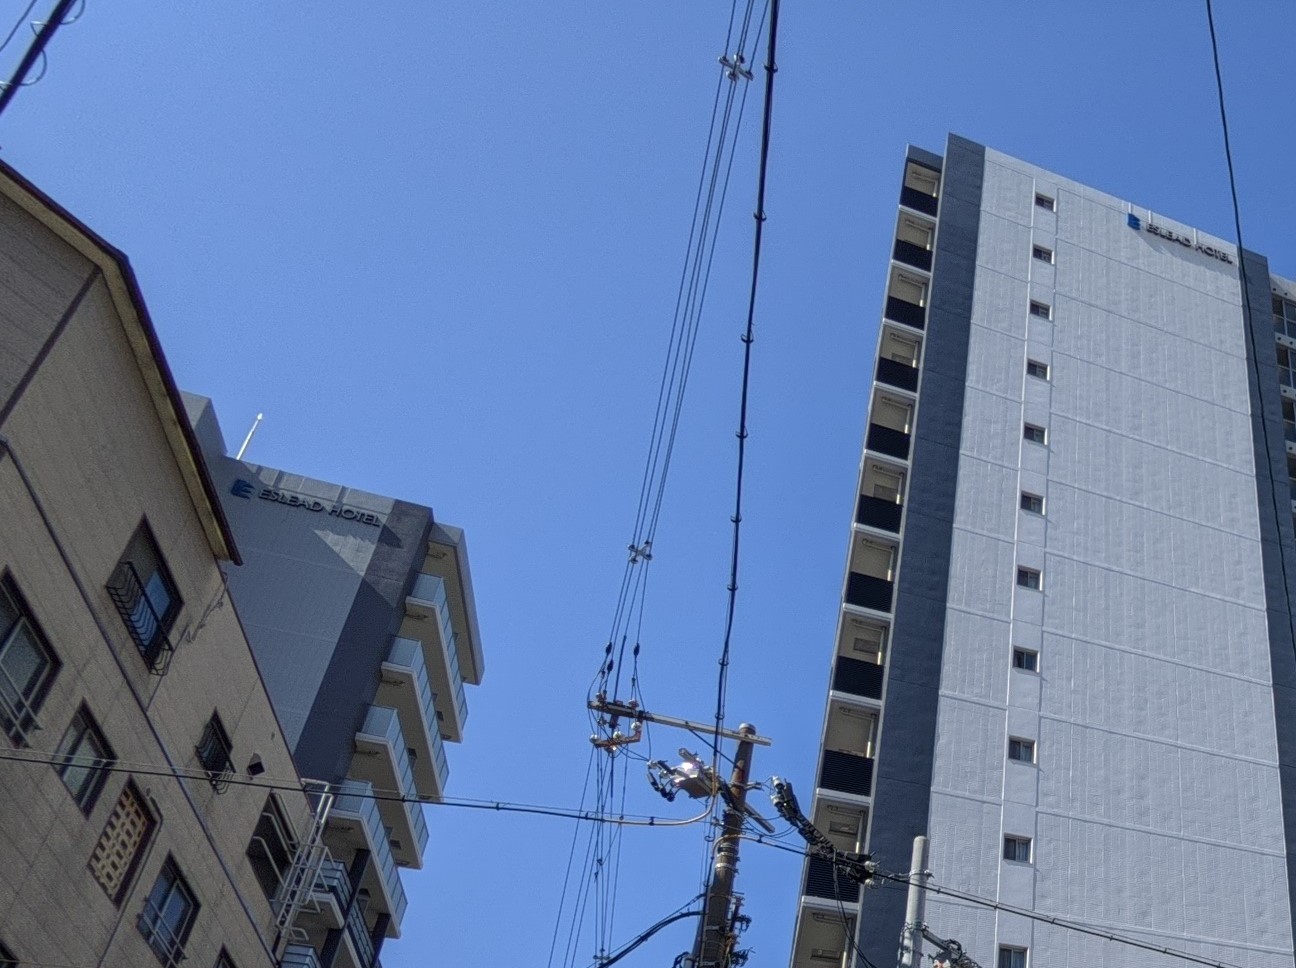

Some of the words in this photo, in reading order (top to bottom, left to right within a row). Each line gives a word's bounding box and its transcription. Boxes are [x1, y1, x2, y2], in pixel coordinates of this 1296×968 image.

[1146, 223, 1191, 247] ESLEAD
[1195, 244, 1233, 264] HOTEL
[258, 488, 323, 513] ESLEAD
[328, 504, 381, 527] HOTEL
